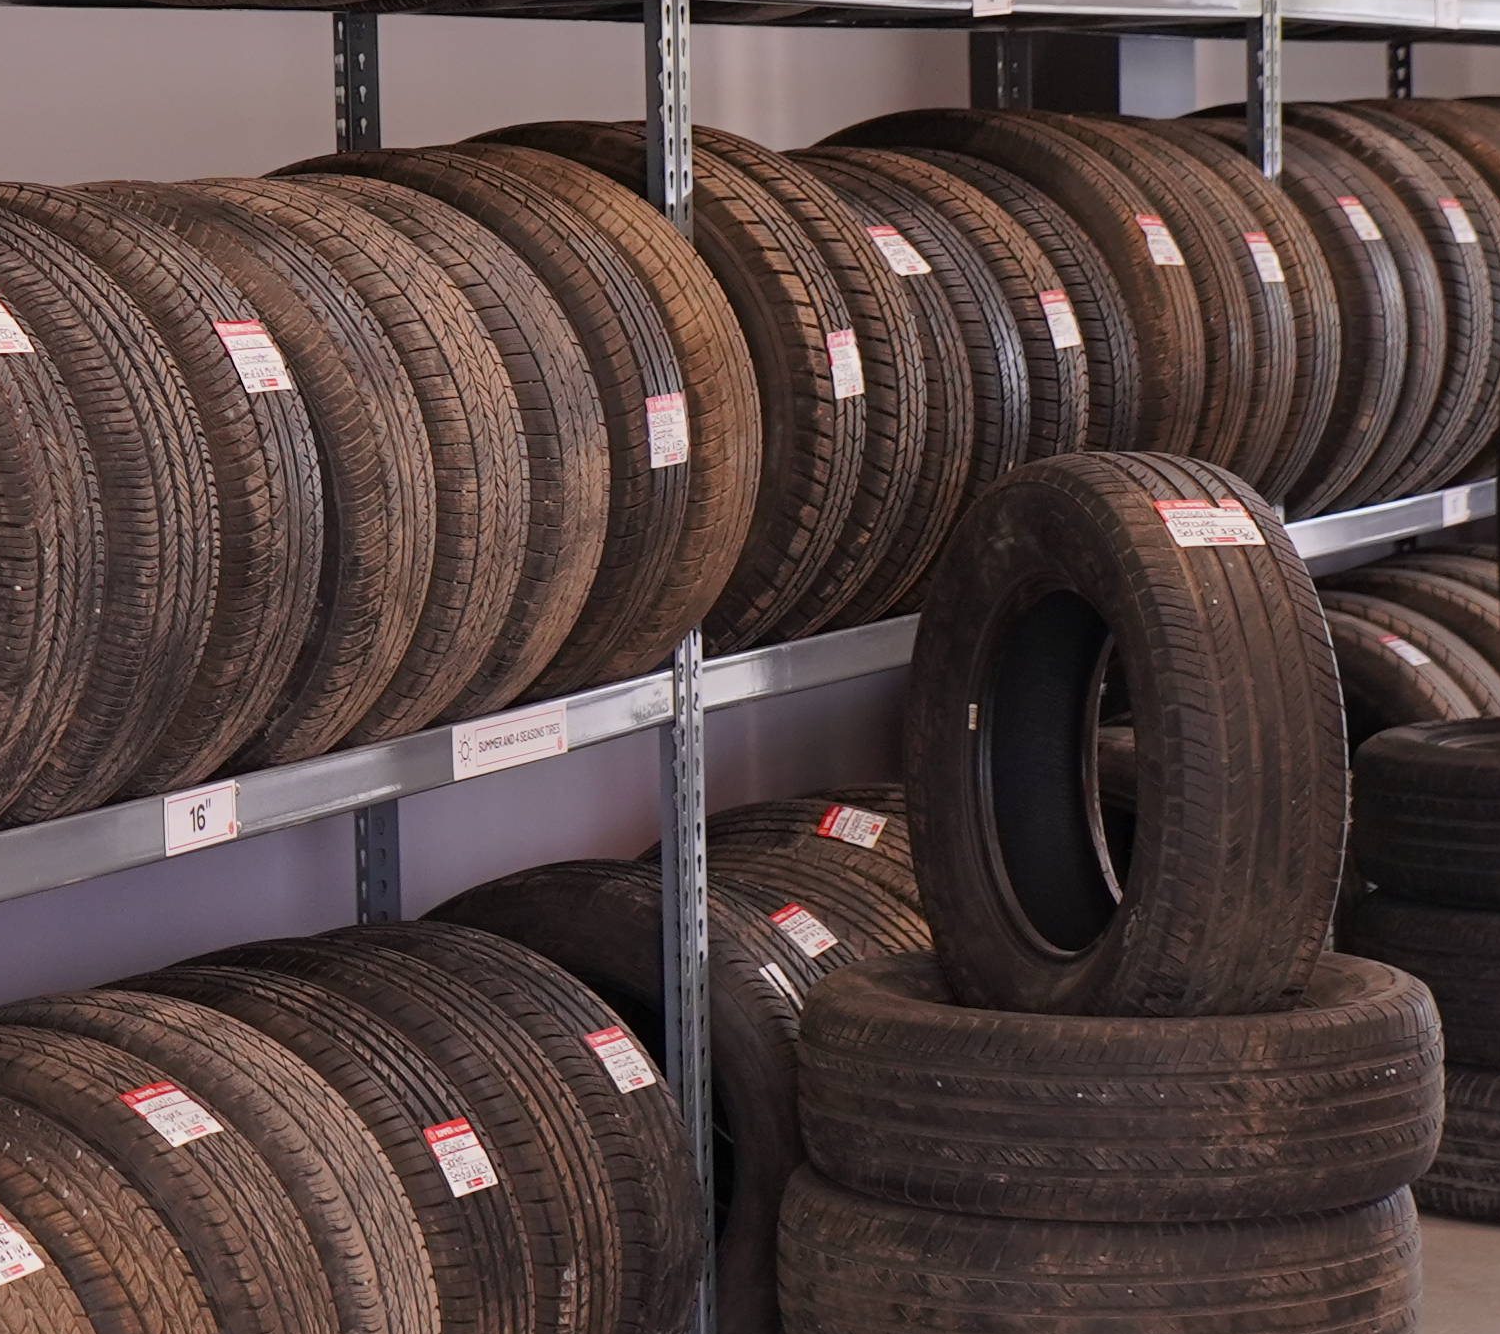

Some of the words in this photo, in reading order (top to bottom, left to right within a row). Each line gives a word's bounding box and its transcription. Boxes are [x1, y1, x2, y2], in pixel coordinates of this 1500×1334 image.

[479, 736, 501, 753] SUMMER
[501, 733, 514, 747] AND
[520, 726, 544, 743] SEASONS
[545, 722, 561, 736] TIRES
[189, 798, 212, 833] 16"
